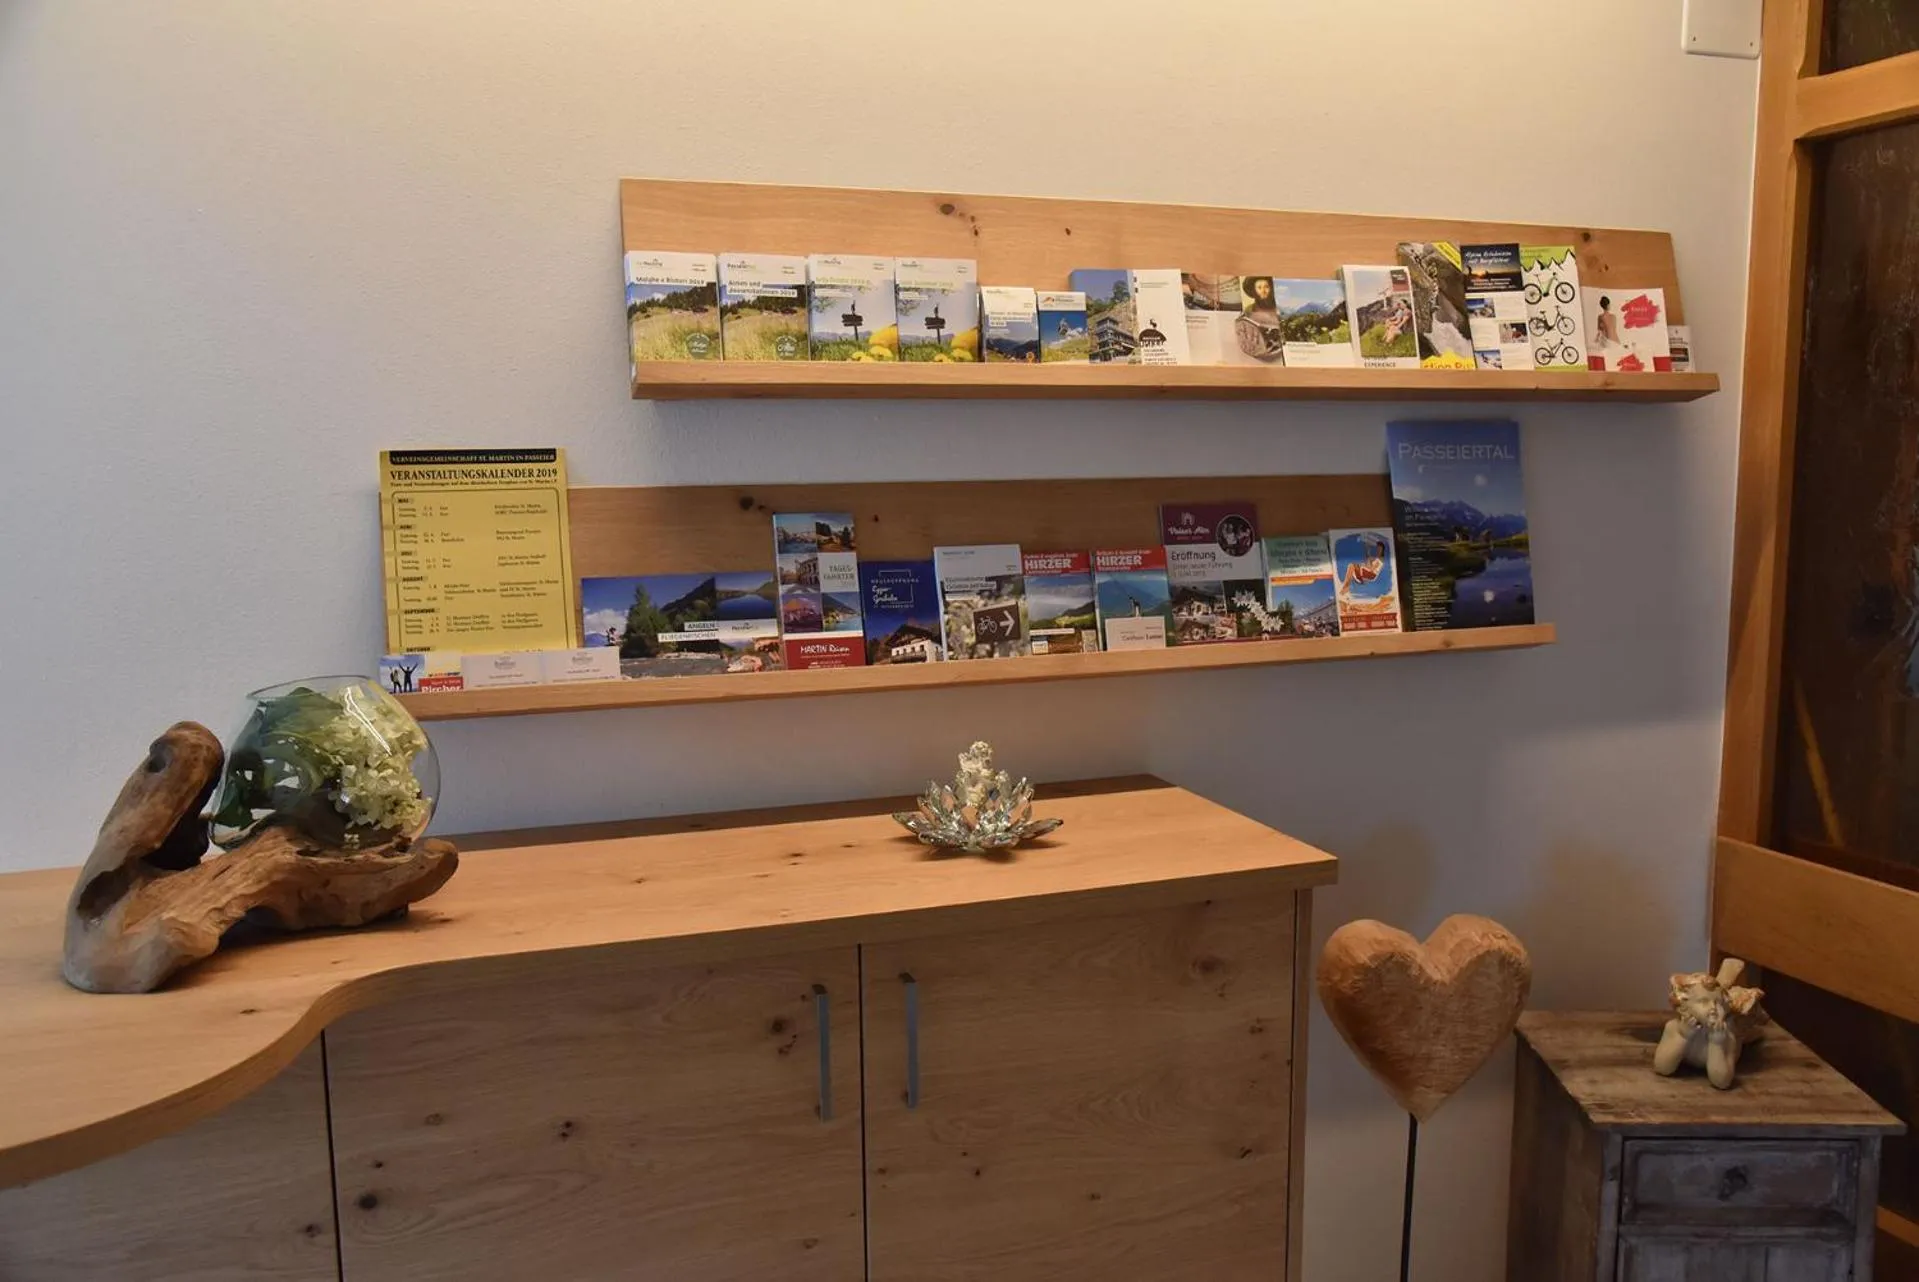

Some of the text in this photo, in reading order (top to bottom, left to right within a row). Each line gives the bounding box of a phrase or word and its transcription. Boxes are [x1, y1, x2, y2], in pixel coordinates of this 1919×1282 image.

[1398, 442, 1515, 460] PASSEIERTAL
[390, 468, 557, 480] VERANSTALTUNGSKALENDER 2019
[1023, 557, 1072, 569] HIRZER
[1096, 554, 1143, 566] HIRZER
[687, 622, 716, 630] ANGELN
[800, 644, 828, 654] MARTIN
